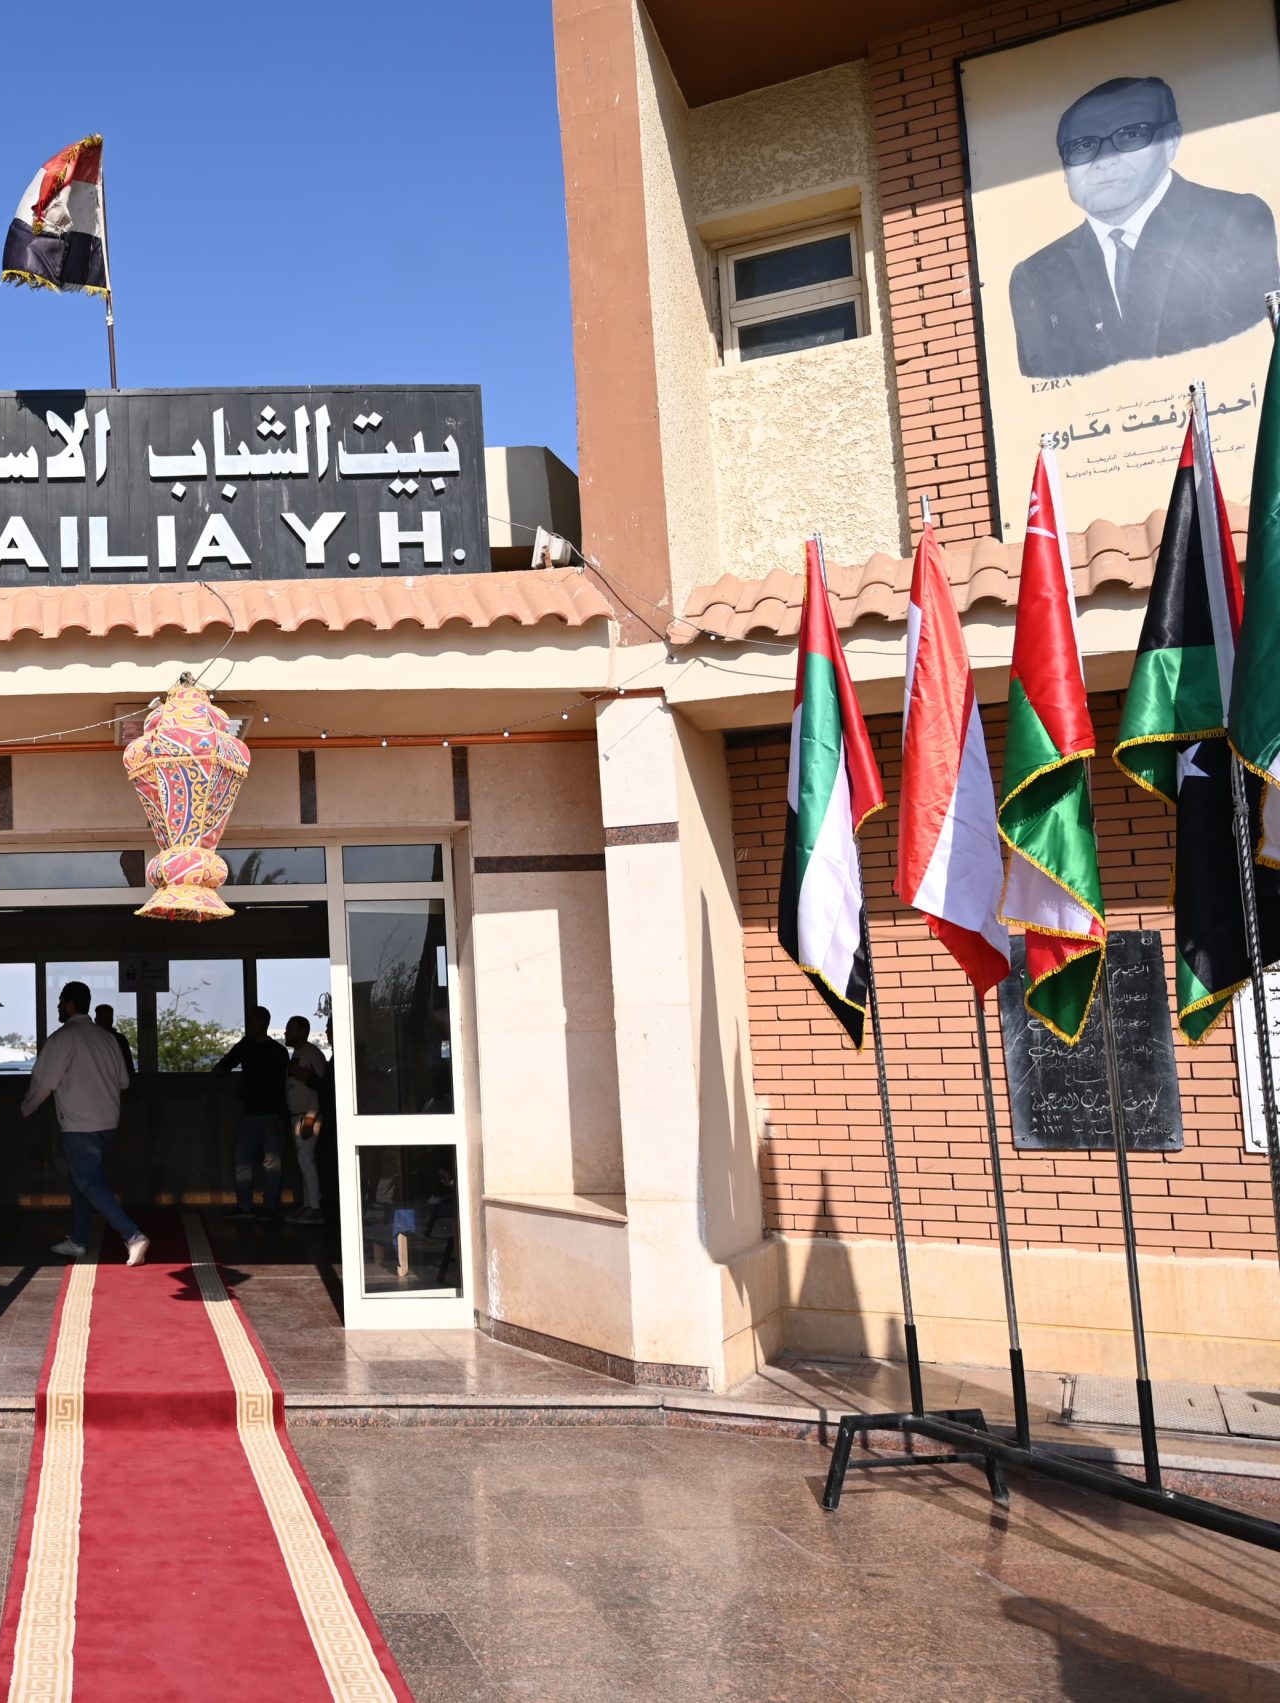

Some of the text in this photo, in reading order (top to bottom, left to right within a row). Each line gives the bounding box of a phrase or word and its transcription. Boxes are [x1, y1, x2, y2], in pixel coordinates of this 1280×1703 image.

[1031, 379, 1072, 393] EZRA
[1207, 382, 1257, 416] أحم
[1122, 404, 1187, 432] رفعت
[148, 404, 332, 500] الشباب
[338, 411, 461, 496] بيت
